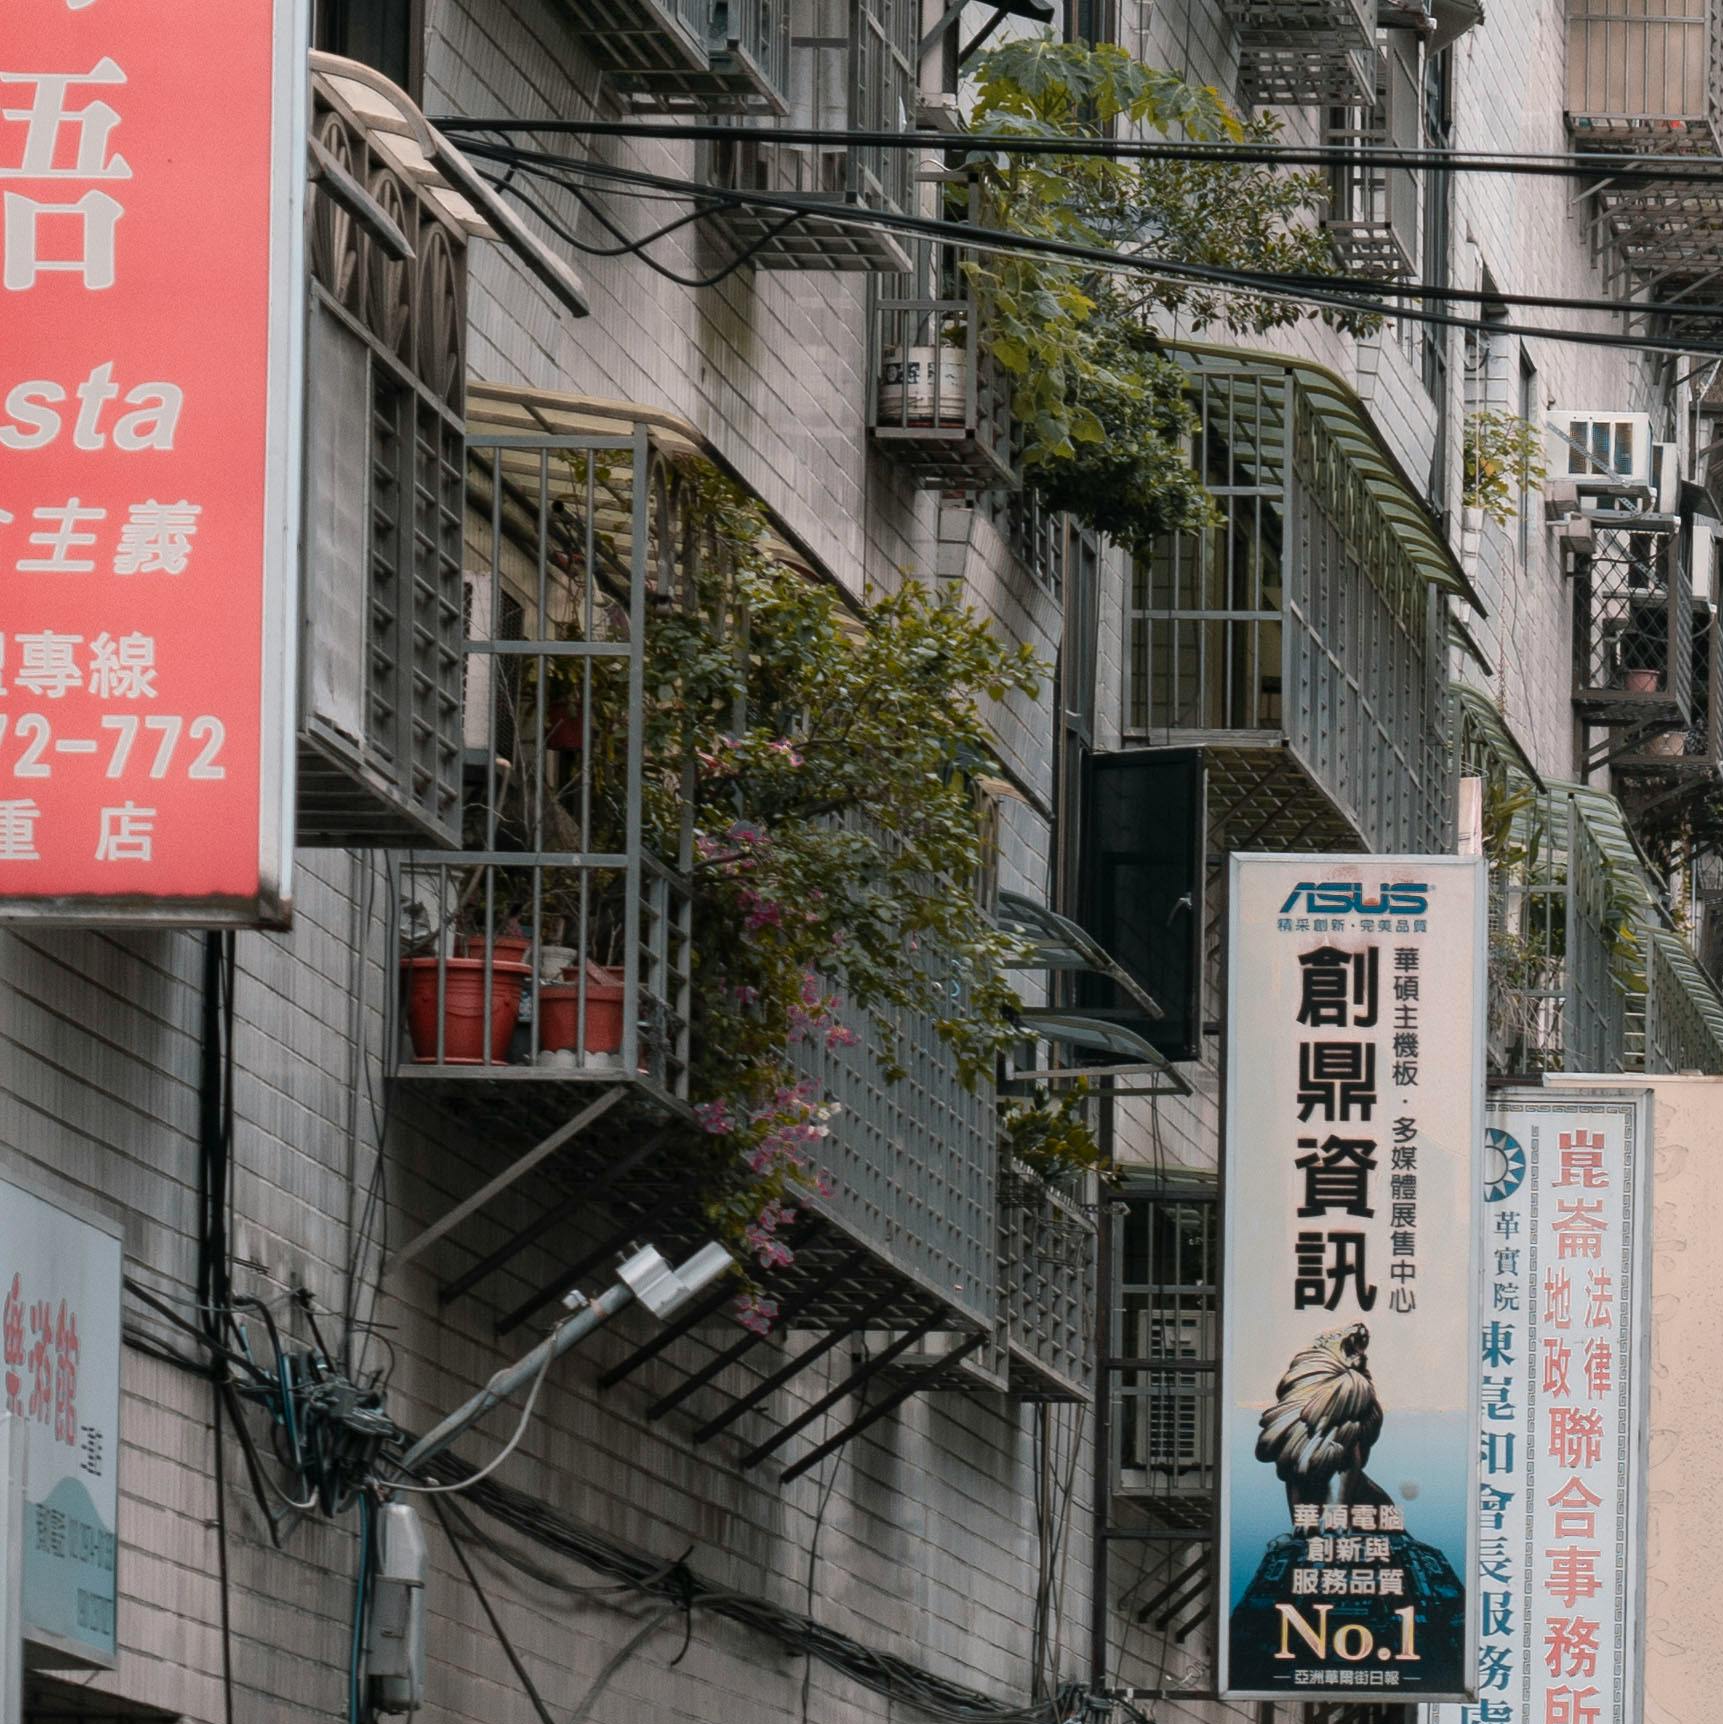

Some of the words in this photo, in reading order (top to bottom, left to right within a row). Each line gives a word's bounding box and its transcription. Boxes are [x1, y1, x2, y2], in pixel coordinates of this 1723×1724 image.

[0, 497, 202, 575] 主義
[0, 630, 158, 698] 專線
[0, 713, 226, 779] 2-772
[1279, 882, 1429, 914] ASUS
[1294, 946, 1379, 1312] 創鼎資訊
[1293, 1503, 1405, 1531] 華碩電腦
[1307, 1535, 1391, 1563] 創新與
[1291, 1567, 1405, 1596] 服務品質
[1273, 1602, 1421, 1661] No.1
